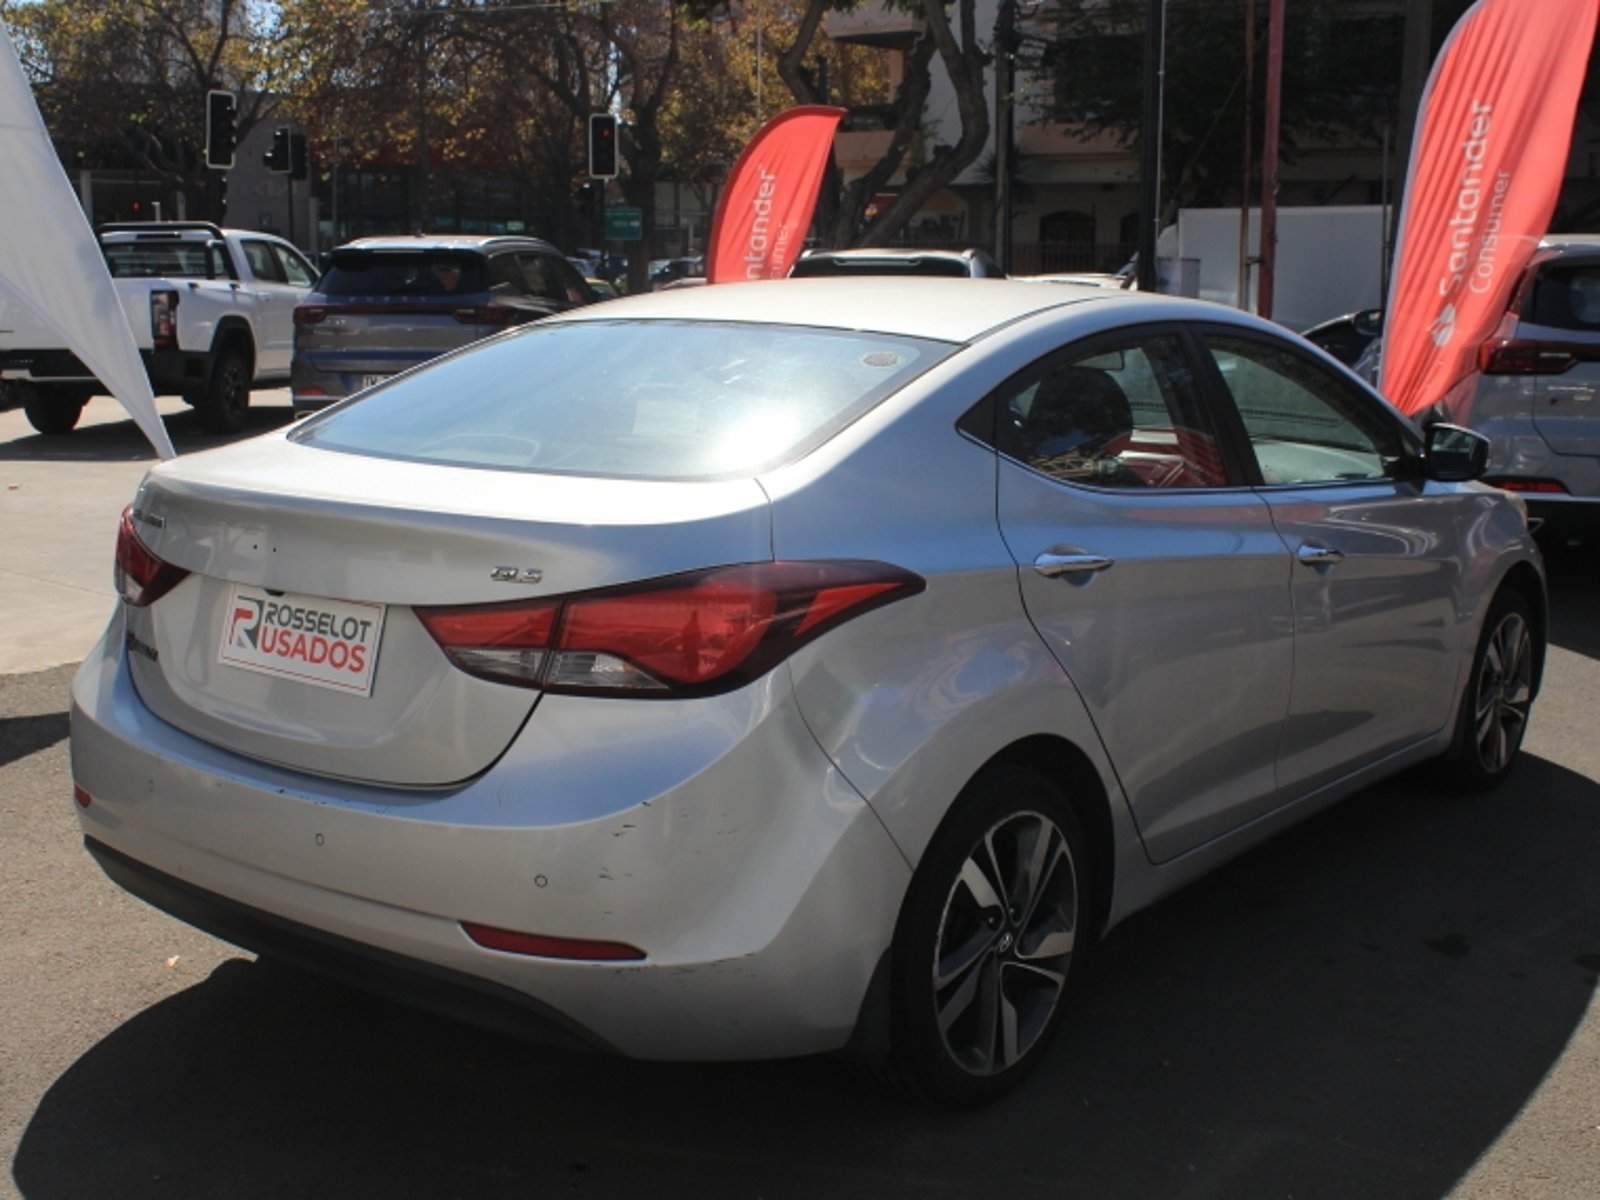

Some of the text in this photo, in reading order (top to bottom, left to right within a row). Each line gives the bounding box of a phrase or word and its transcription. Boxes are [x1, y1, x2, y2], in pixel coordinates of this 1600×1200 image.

[743, 169, 776, 280] ntander
[1439, 98, 1493, 297] Santander
[1467, 169, 1511, 295] Consumer
[260, 626, 367, 673] USADOS
[264, 602, 372, 643] ROSSELOT
